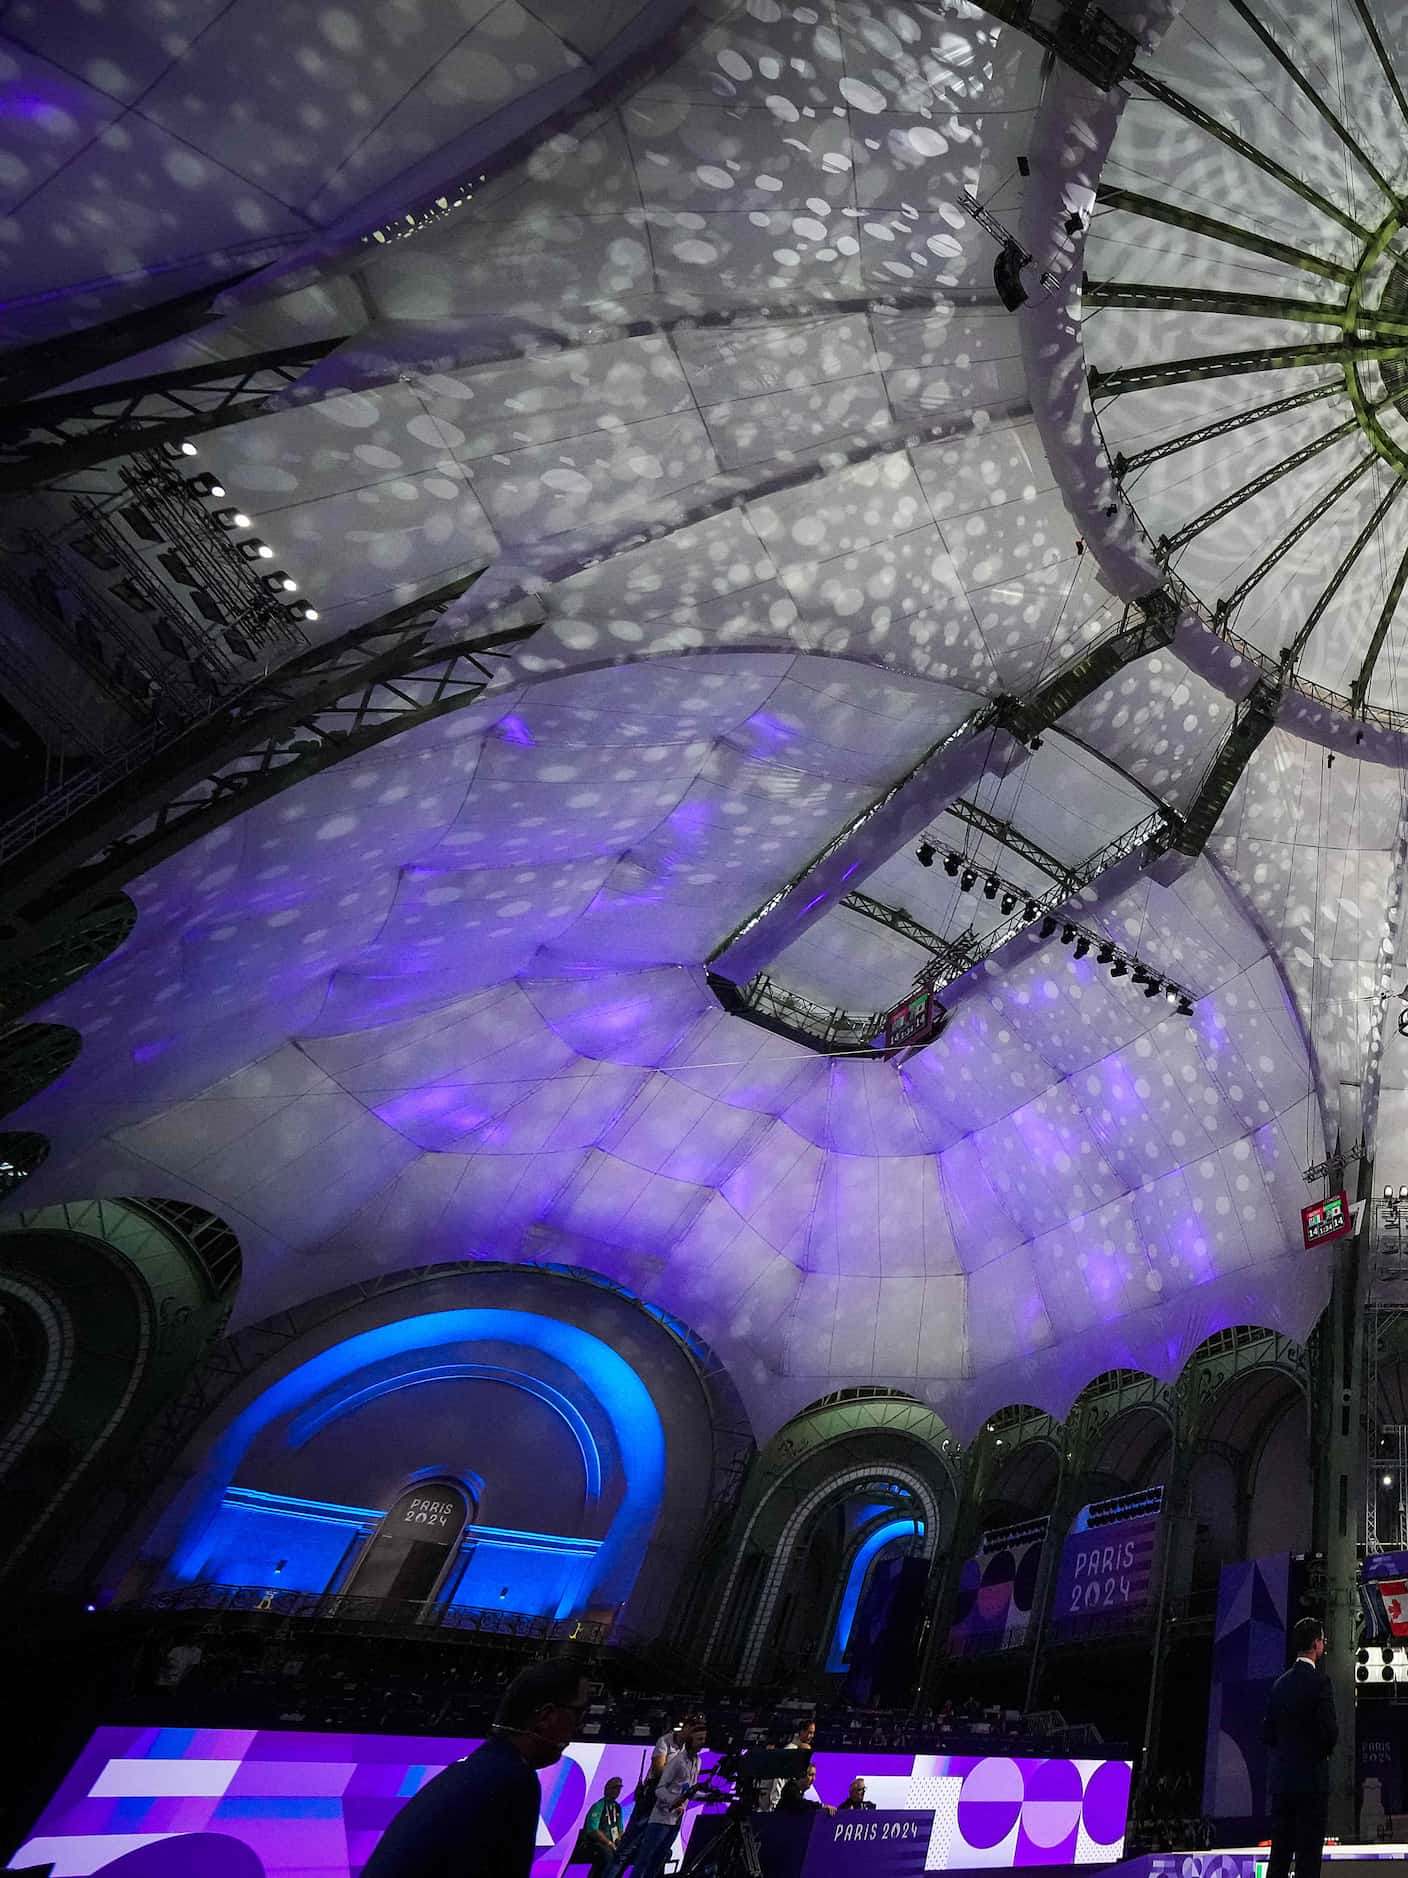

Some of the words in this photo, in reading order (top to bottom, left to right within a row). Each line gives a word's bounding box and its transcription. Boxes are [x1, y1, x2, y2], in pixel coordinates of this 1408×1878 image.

[410, 1499, 453, 1515] PARIS
[404, 1510, 447, 1527] 2024
[1074, 1541, 1134, 1579] PARIS
[1069, 1576, 1130, 1612] 2024
[834, 1824, 877, 1842] PARIS
[881, 1822, 917, 1840] 2024
